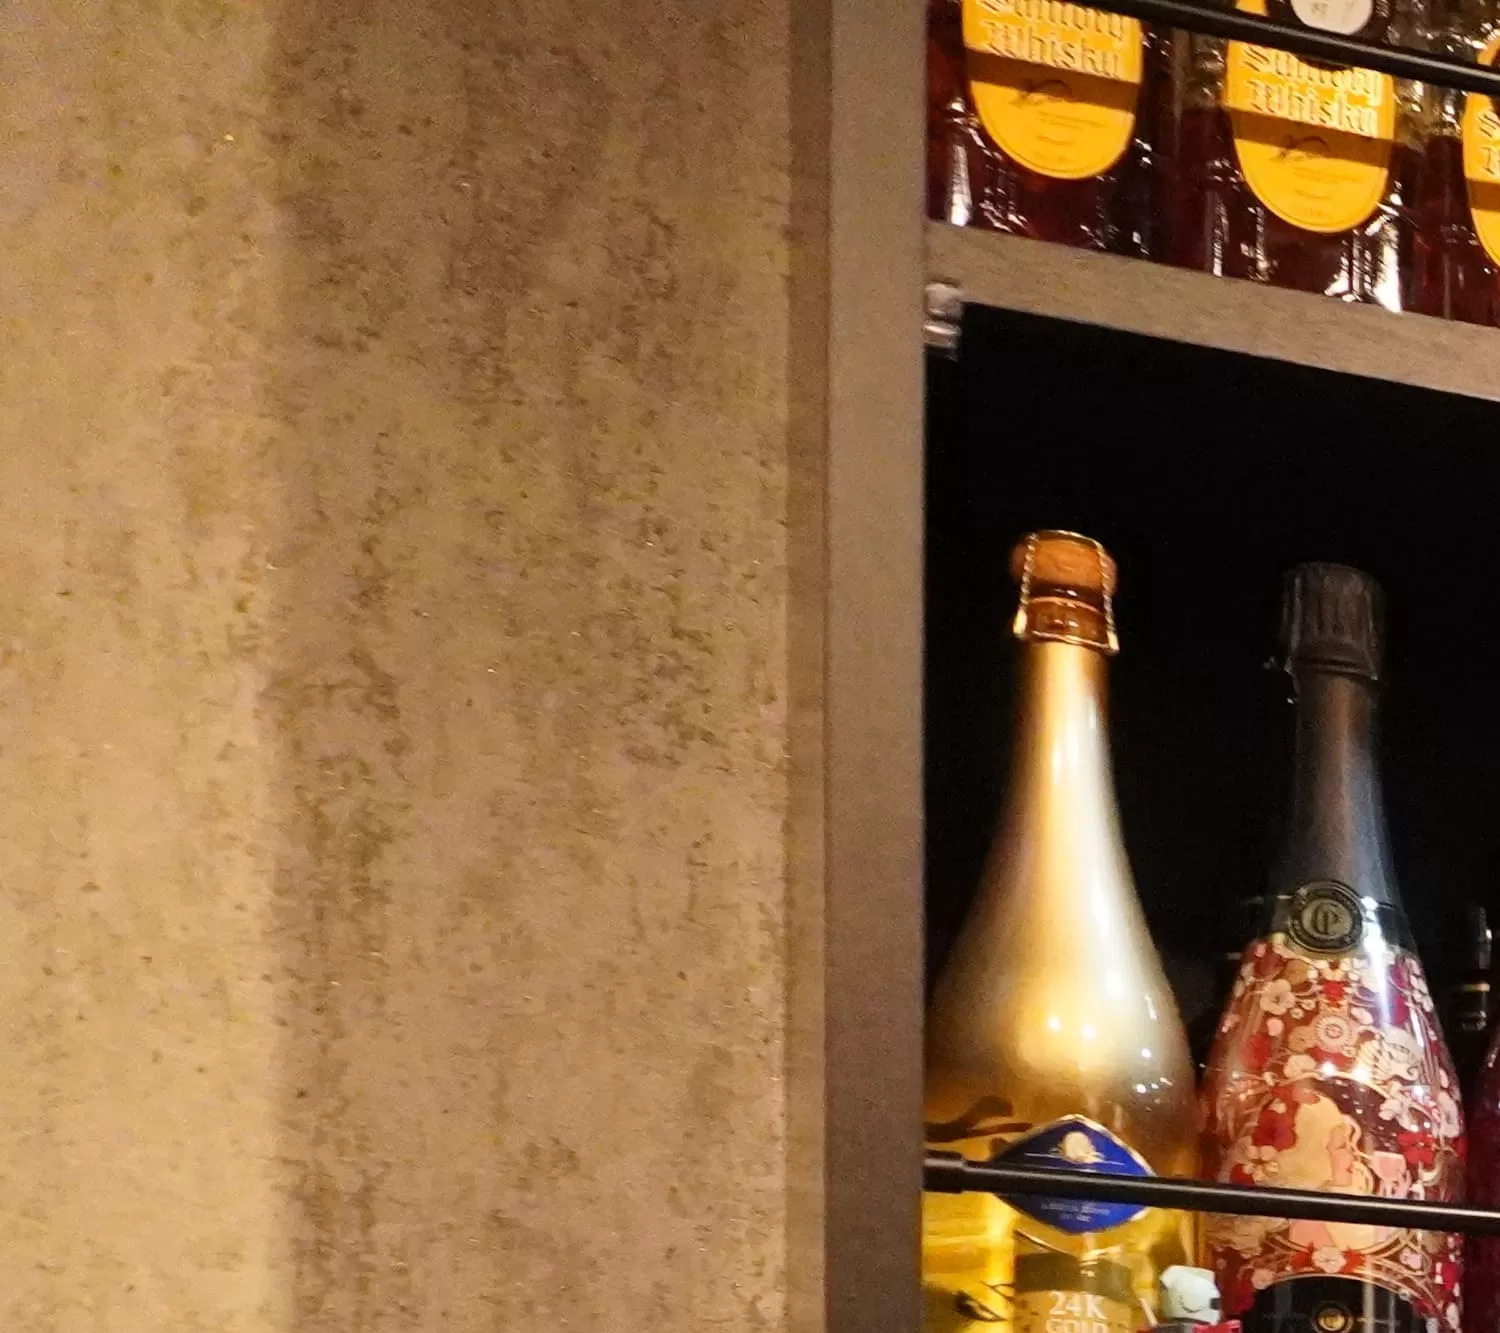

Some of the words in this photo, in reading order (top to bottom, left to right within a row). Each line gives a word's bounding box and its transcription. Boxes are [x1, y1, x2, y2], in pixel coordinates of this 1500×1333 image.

[981, 18, 1122, 79] Whisky
[1246, 79, 1380, 137] Whisky
[1048, 1290, 1107, 1320] 24K
